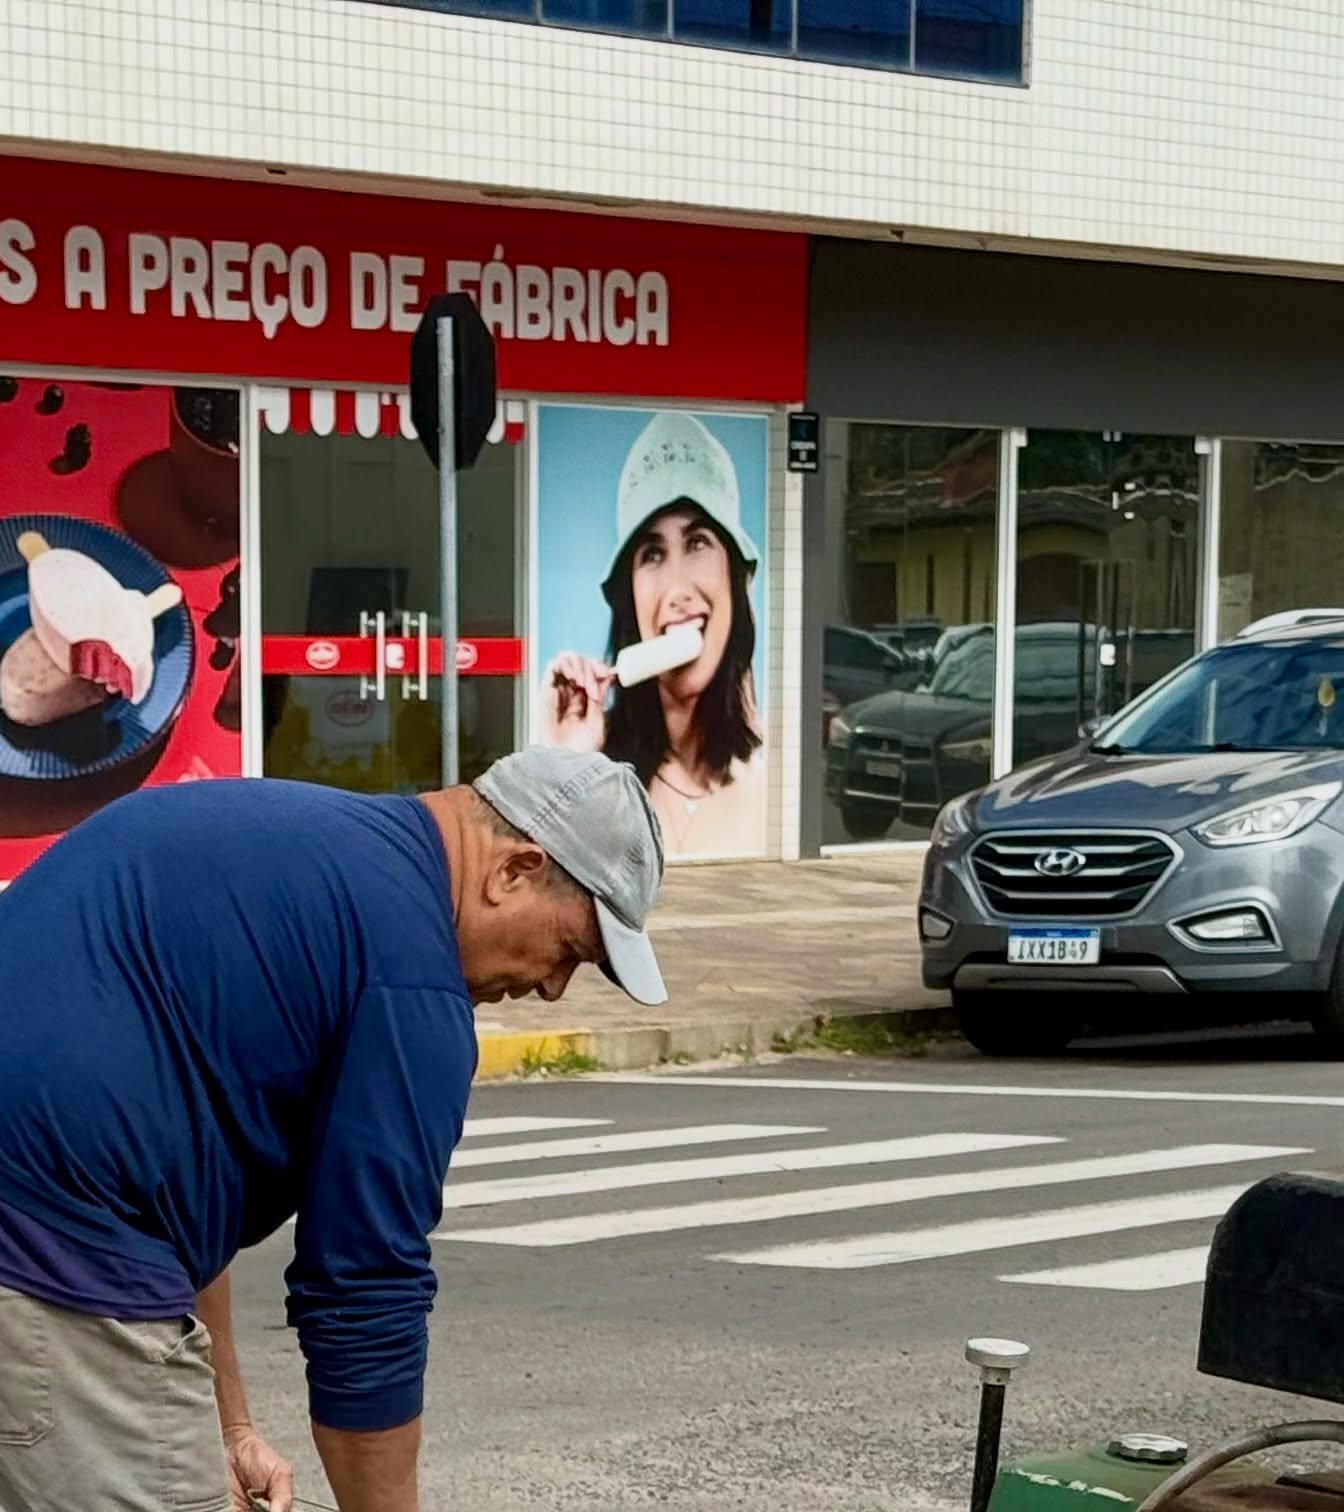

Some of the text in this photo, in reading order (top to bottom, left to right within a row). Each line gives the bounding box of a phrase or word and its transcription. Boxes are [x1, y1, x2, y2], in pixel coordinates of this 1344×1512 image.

[63, 225, 106, 311] A
[128, 232, 328, 340] PREÇO
[349, 251, 426, 333] DE
[445, 243, 670, 347] FÁBRICA
